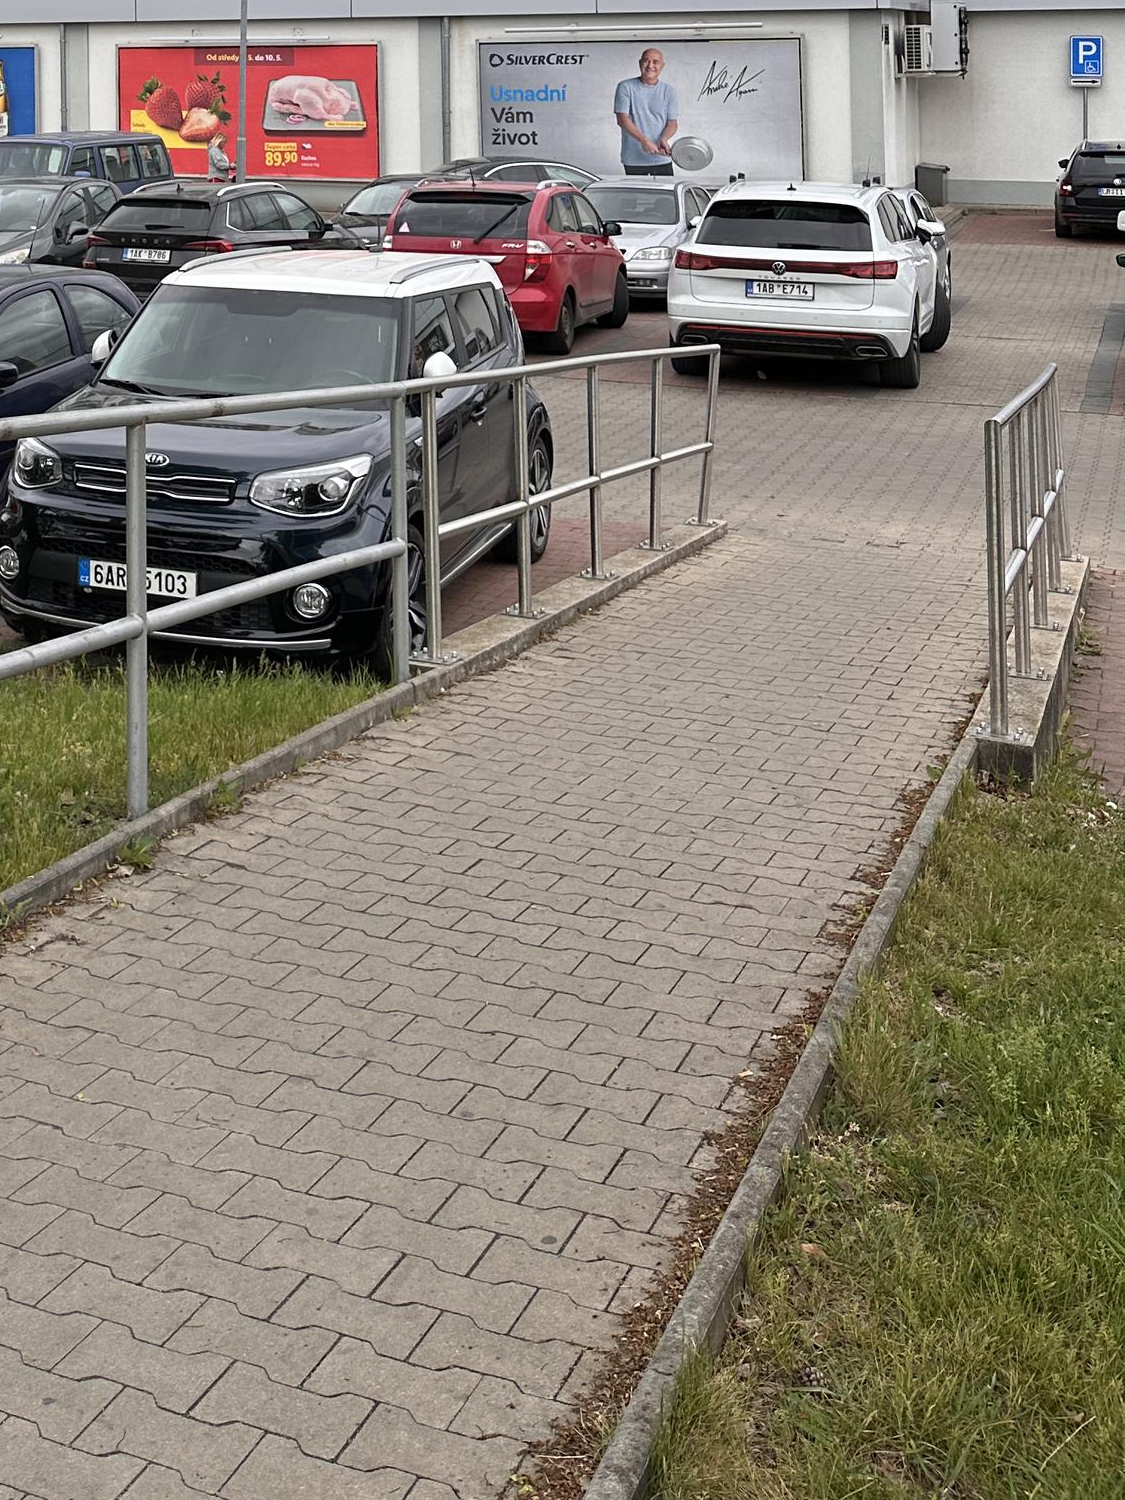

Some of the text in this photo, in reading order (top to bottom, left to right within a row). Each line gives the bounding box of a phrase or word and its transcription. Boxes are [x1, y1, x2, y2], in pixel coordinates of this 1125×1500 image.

[218, 54, 239, 62] středy
[1078, 41, 1097, 64] P
[491, 84, 567, 102] Usnadní
[491, 108, 533, 124] Vám
[492, 129, 538, 146] život
[265, 151, 298, 167] 89.90
[756, 282, 809, 296] 1AB E714
[94, 564, 126, 587] 6AR
